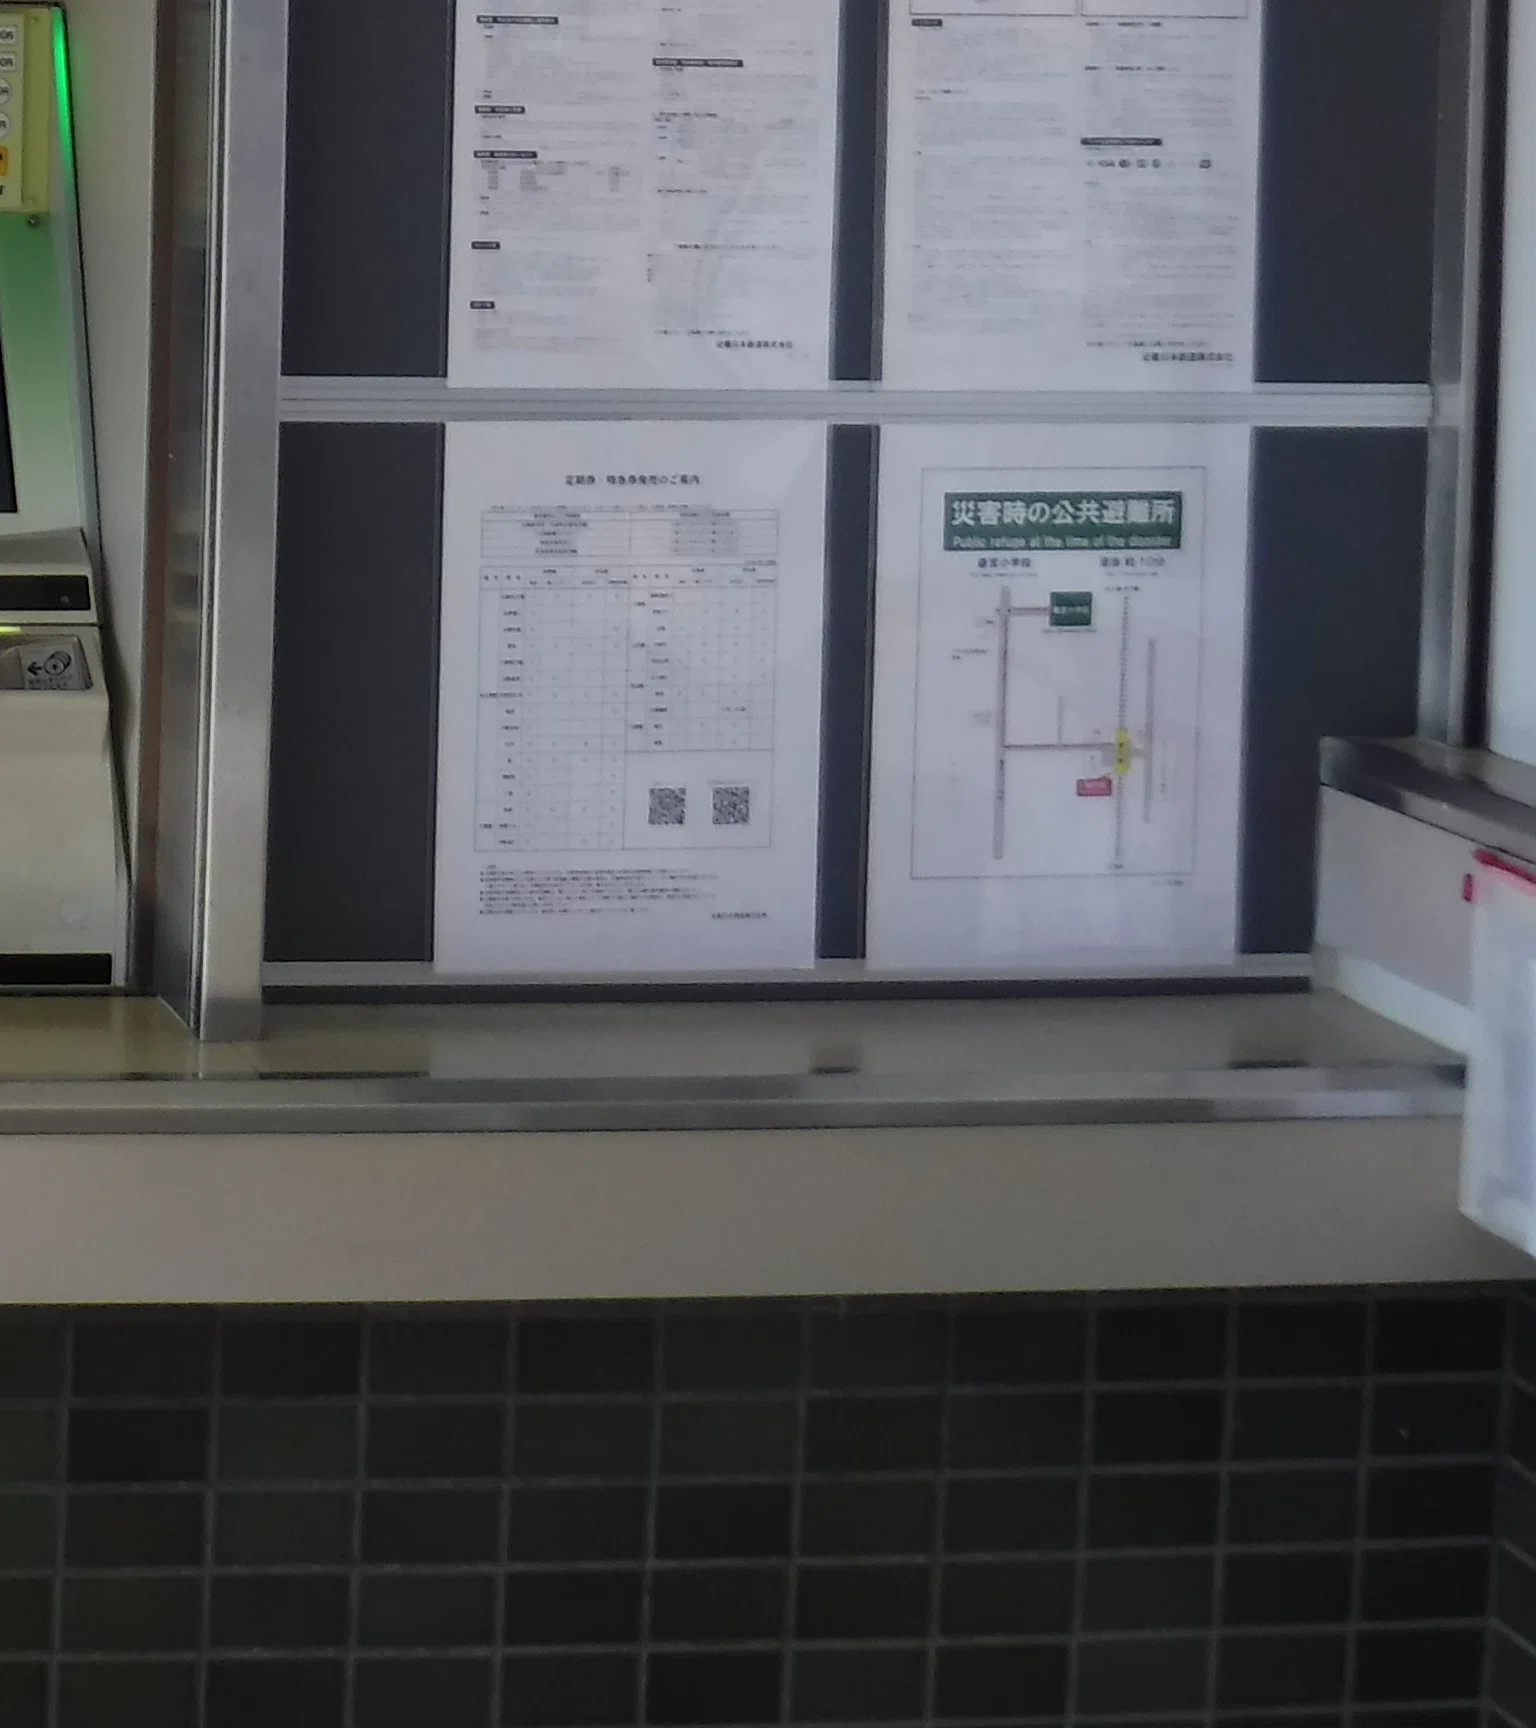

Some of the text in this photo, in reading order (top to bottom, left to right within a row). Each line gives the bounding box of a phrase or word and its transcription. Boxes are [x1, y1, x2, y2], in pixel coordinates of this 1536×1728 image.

[952, 500, 1174, 525] 災害時の公共避難所
